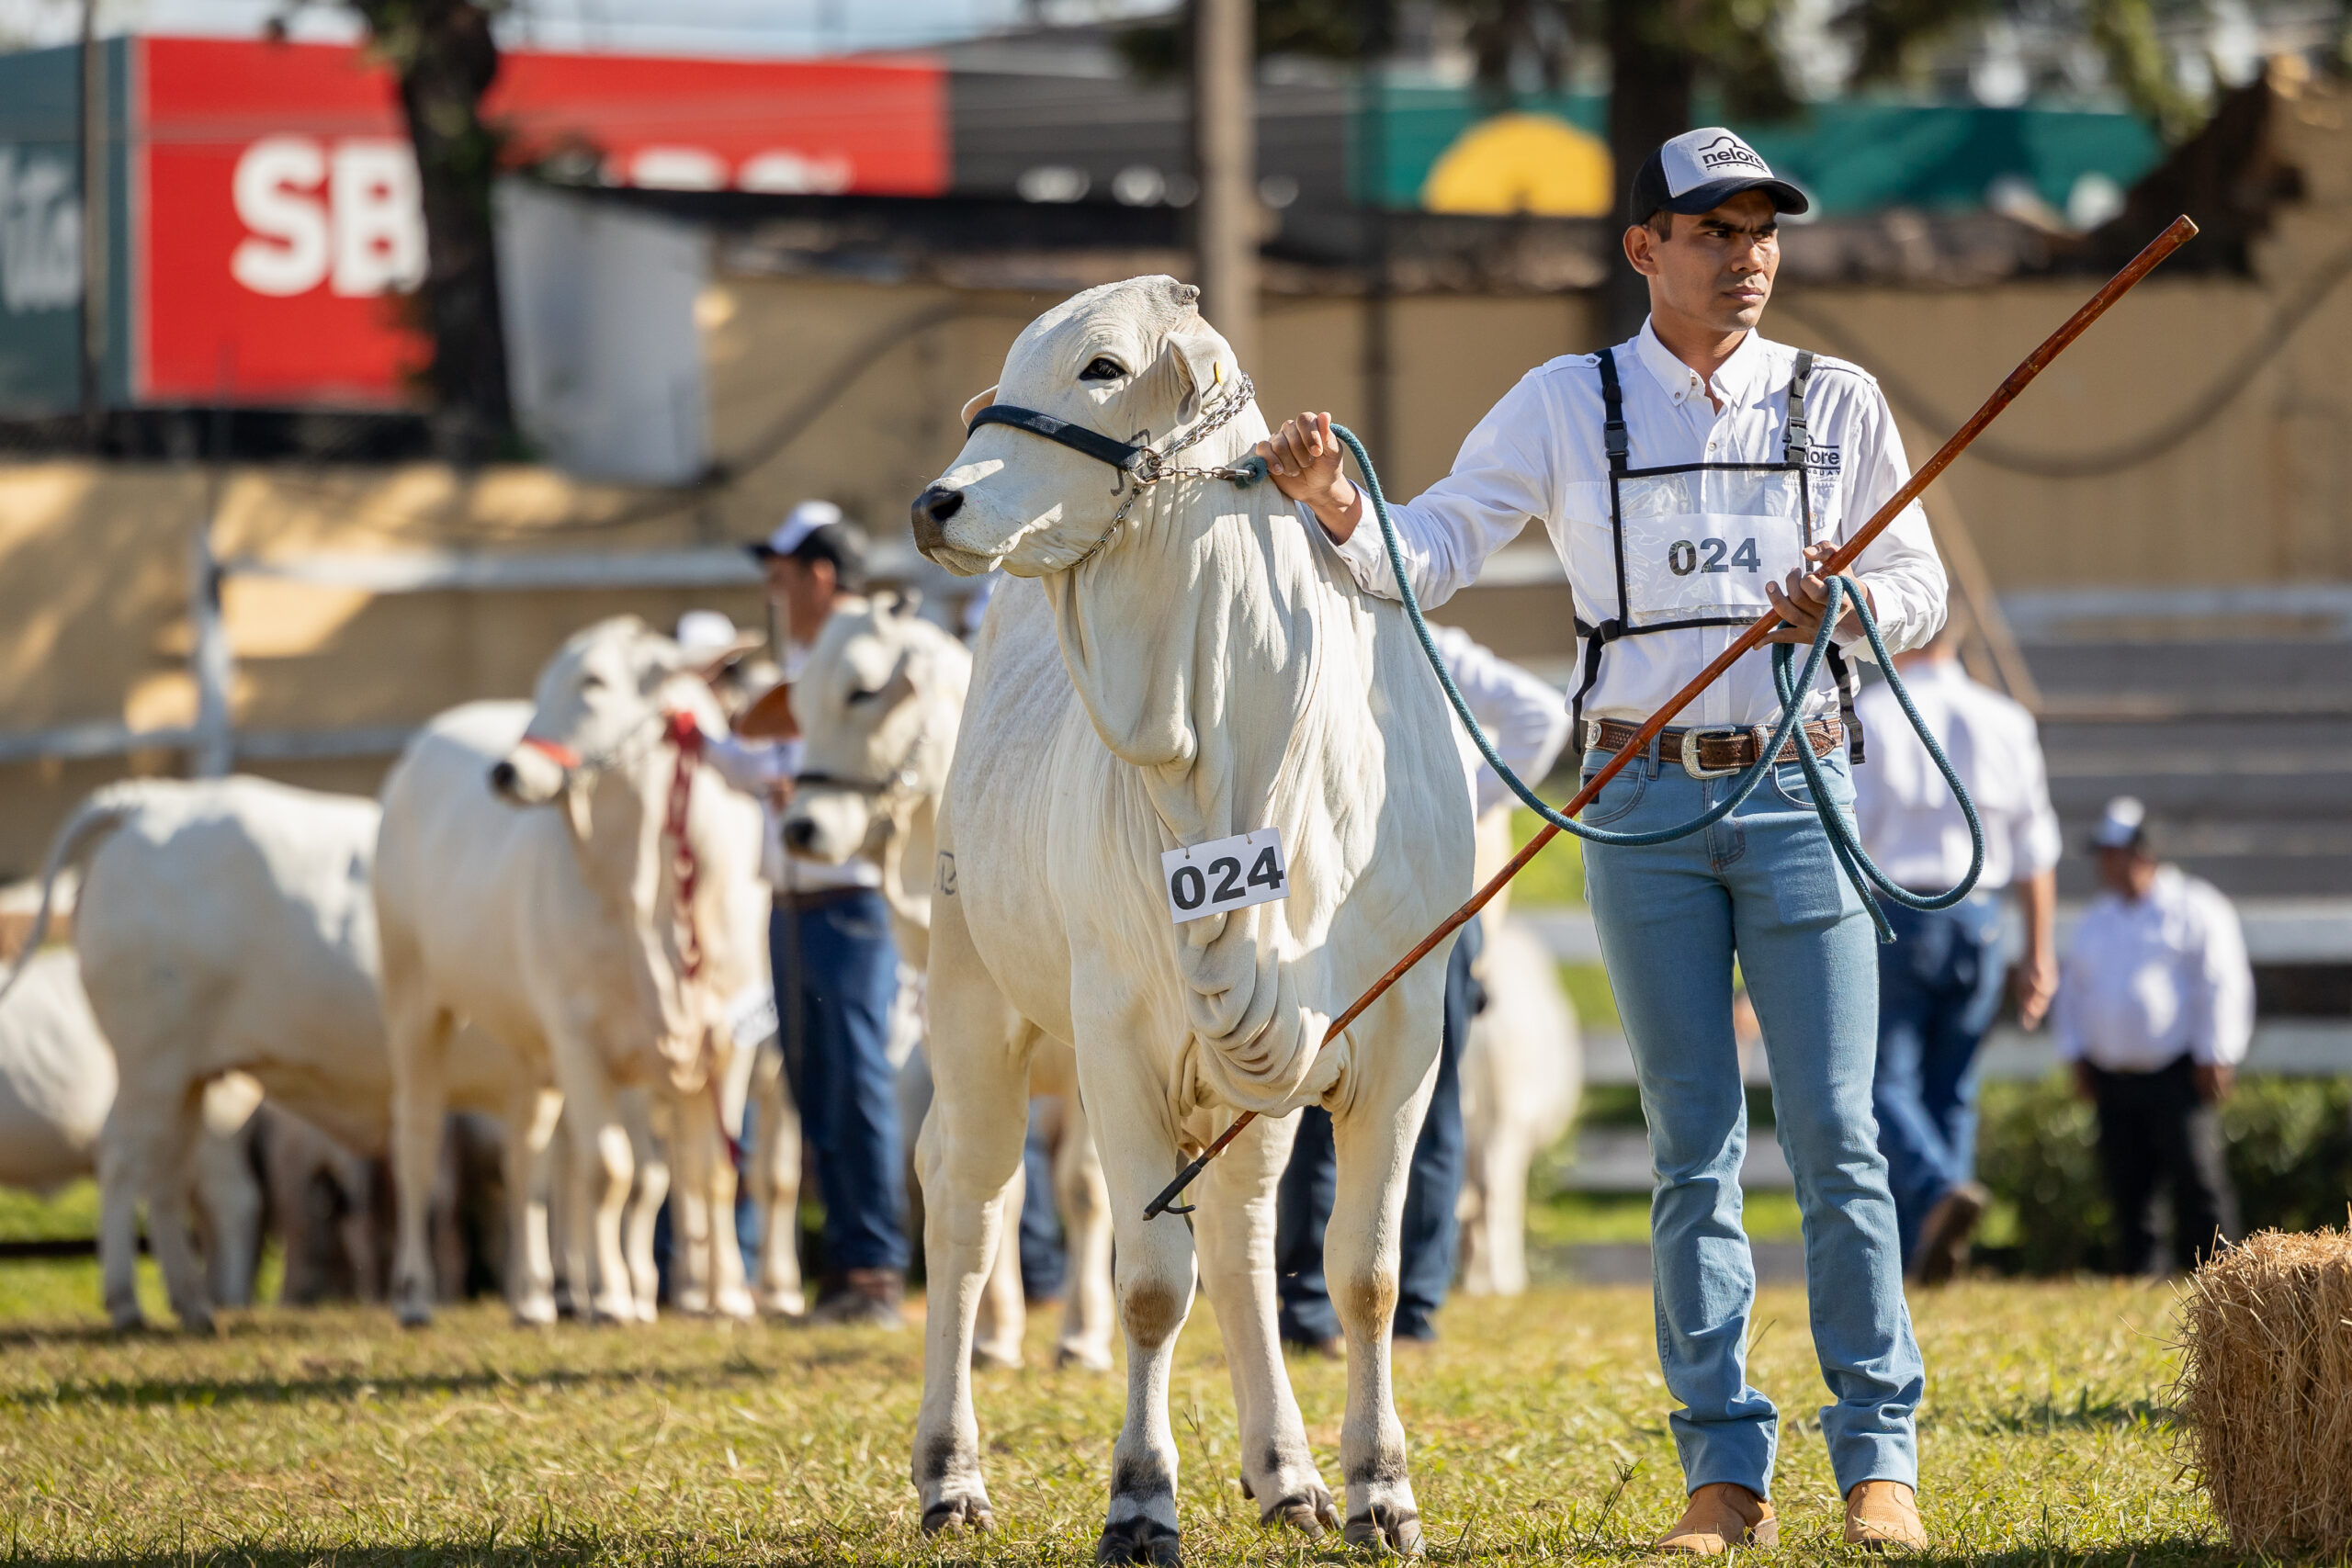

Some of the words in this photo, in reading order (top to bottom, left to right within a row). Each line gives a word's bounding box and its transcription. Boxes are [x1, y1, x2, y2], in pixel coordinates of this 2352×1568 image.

[1702, 148, 1765, 169] nelore
[1806, 446, 1840, 465] lore
[1668, 537, 1761, 576] 024
[1170, 846, 1284, 911] 024
